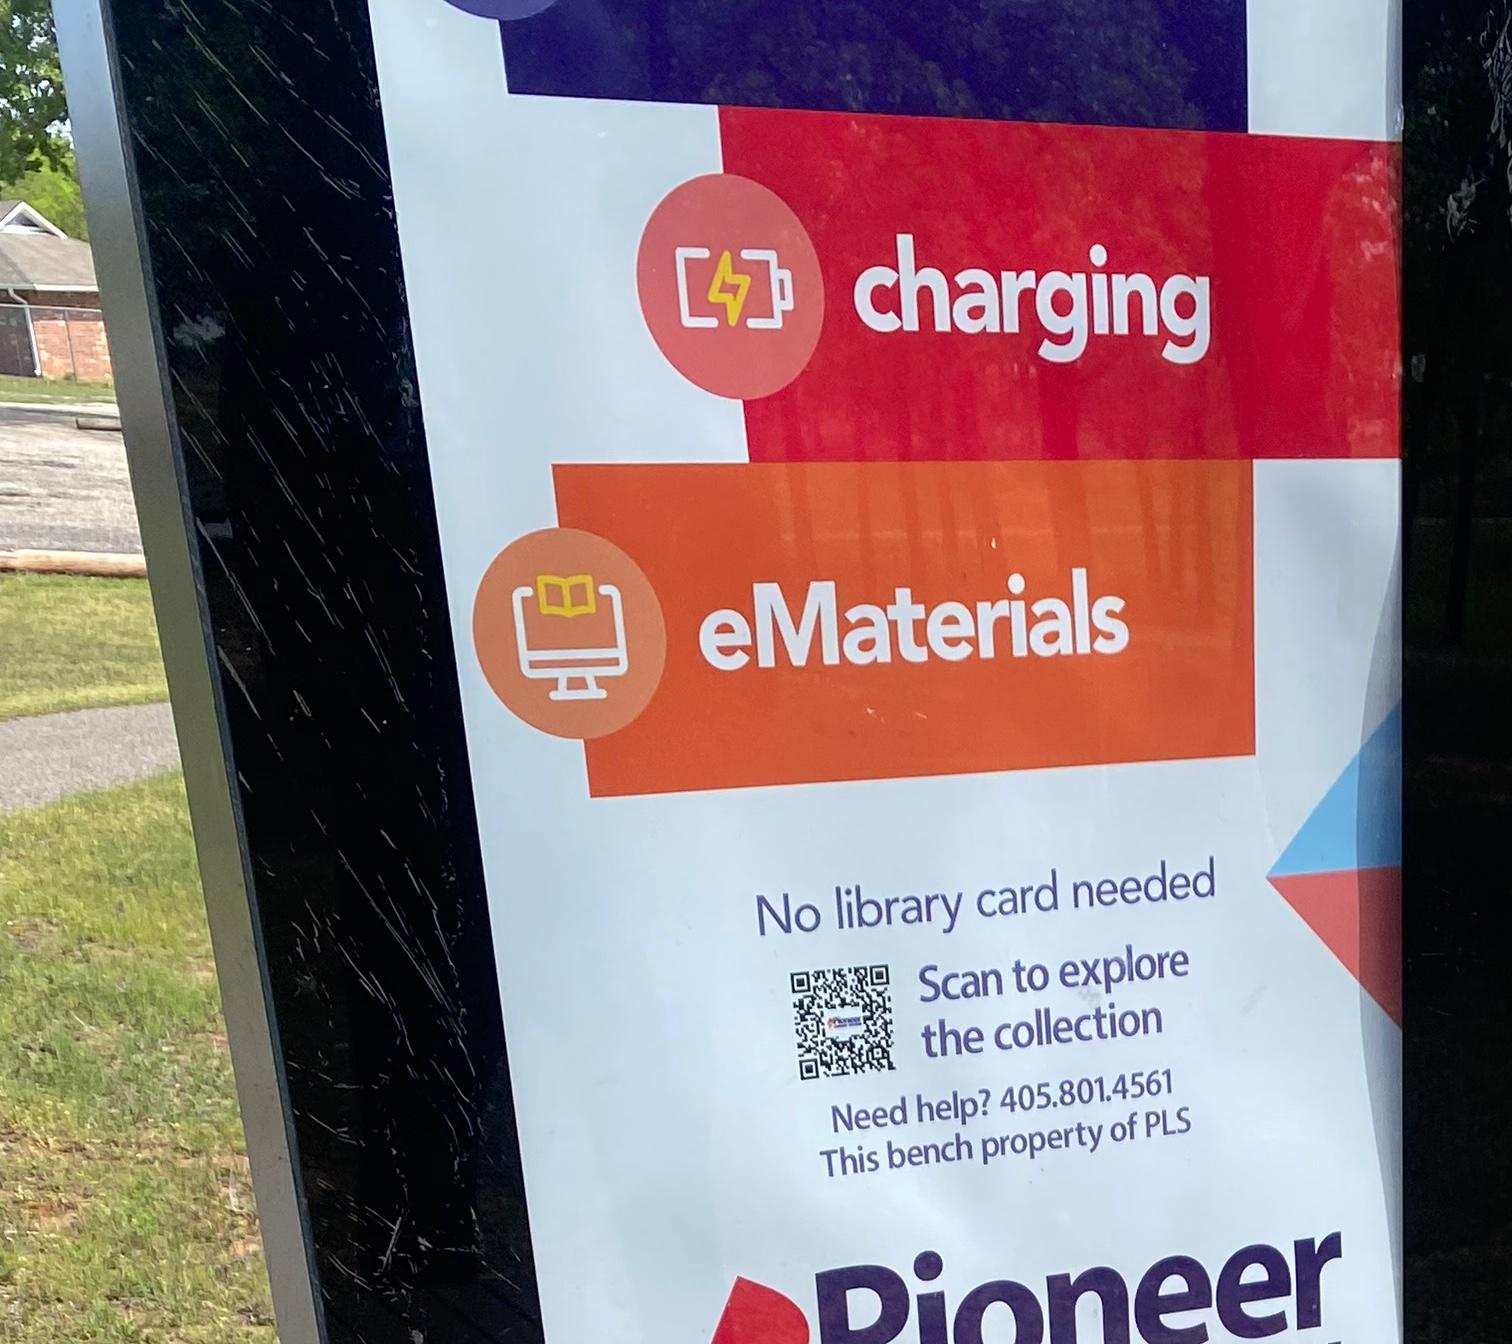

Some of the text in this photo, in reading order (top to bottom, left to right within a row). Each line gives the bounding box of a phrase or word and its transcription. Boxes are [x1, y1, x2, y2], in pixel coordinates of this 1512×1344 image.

[854, 234, 1210, 364] charging
[699, 568, 1129, 670] eMaterials
[757, 856, 1215, 936] No library card needed
[919, 944, 1189, 1002] Scan to explore
[921, 1003, 1162, 1057] the collection
[832, 1069, 1172, 1132] Need help? 405.801.4561
[820, 1107, 1191, 1177] This bench property of PLS
